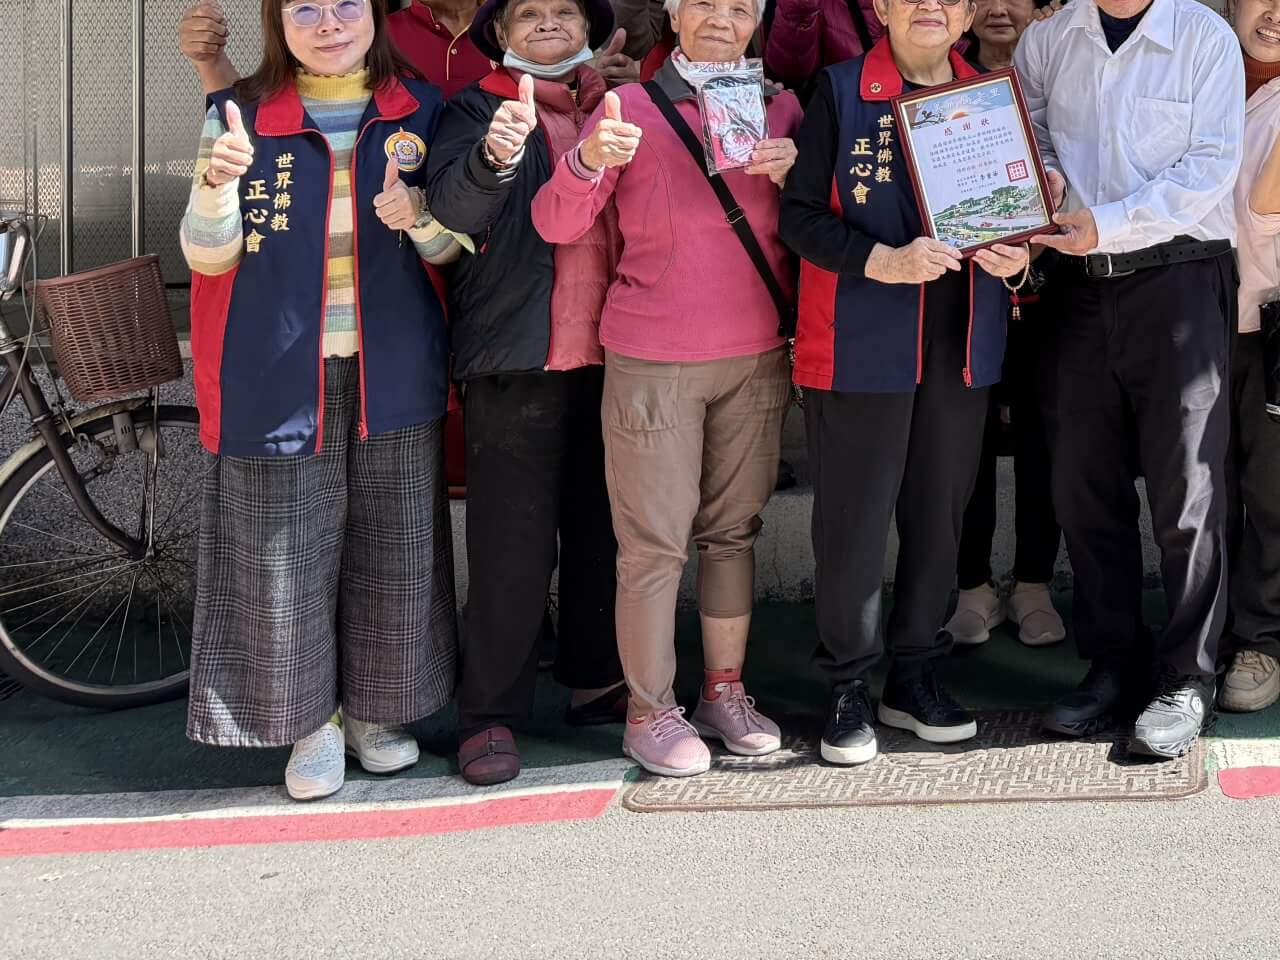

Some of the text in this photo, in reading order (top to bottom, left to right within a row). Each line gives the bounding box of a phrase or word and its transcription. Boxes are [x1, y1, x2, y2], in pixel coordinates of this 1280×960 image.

[850, 138, 874, 205] 正心會
[874, 114, 895, 183] 世界佛教
[244, 178, 271, 254] 正心會
[270, 152, 296, 232] 世界佛教
